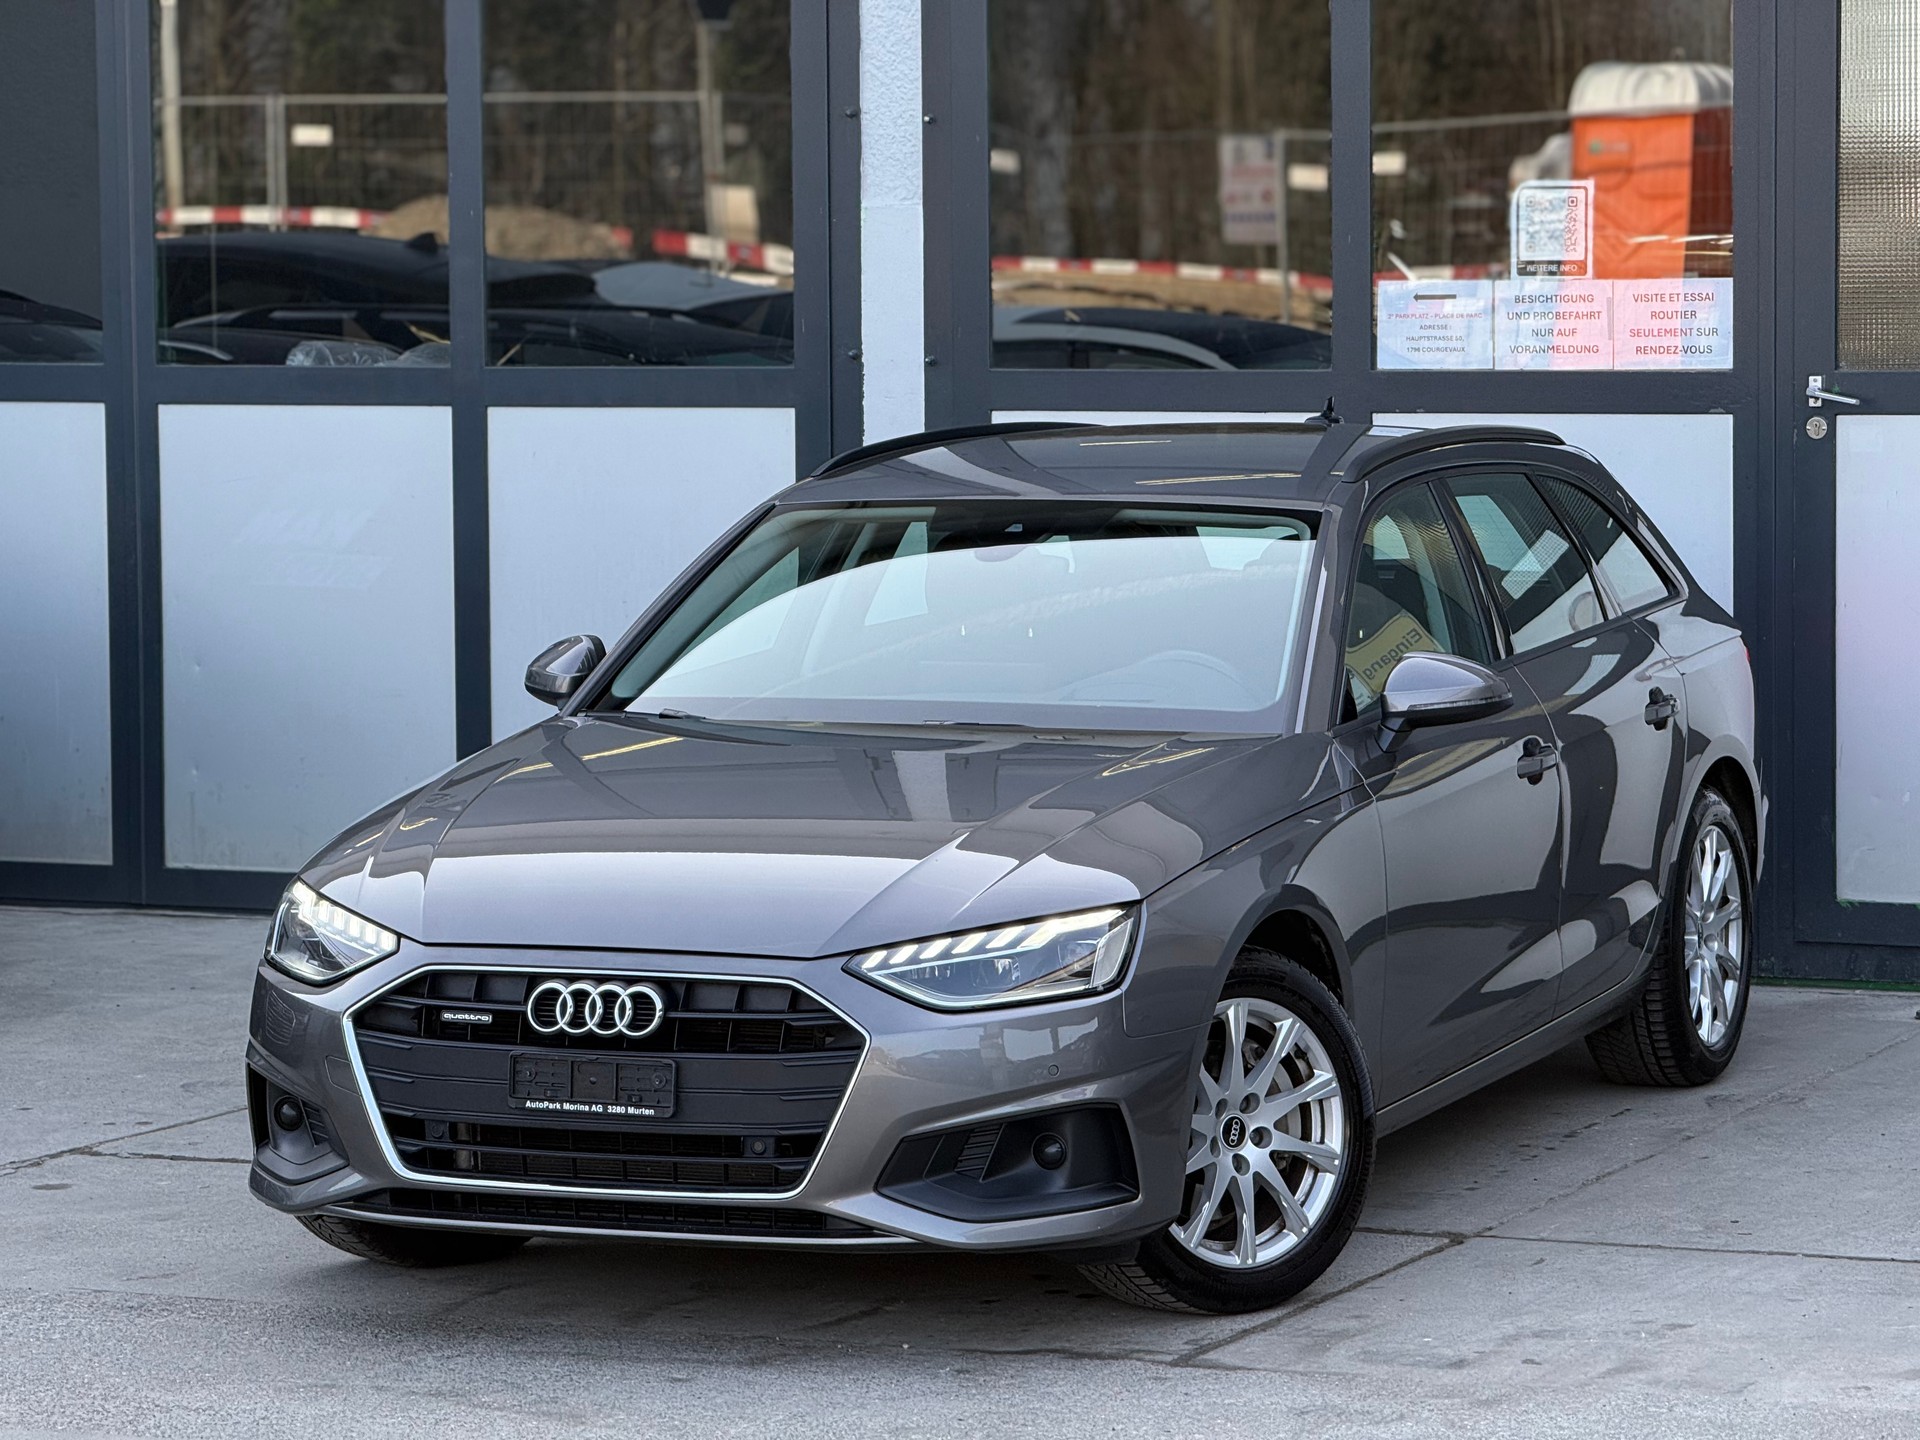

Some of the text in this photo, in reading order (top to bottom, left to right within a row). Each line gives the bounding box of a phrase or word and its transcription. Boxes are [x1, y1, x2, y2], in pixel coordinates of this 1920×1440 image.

[1526, 264, 1578, 272] WEITERE INFO
[1514, 294, 1595, 304] BESICHTIGUNG
[1632, 292, 1715, 303] VISITE ET ESSAI
[1507, 311, 1602, 321] UND PROBEFAHRT
[1650, 310, 1697, 320] ROUTIER
[1531, 328, 1578, 338] NUR AUF
[1629, 327, 1719, 338] SEULEMENT SUR
[1509, 345, 1600, 354] VORANMELDUNG
[1635, 345, 1713, 355] RENDEZ-VOUS
[443, 1013, 489, 1021] quattro
[525, 1100, 655, 1116] AutoPark Morina AG 3280 Murten
